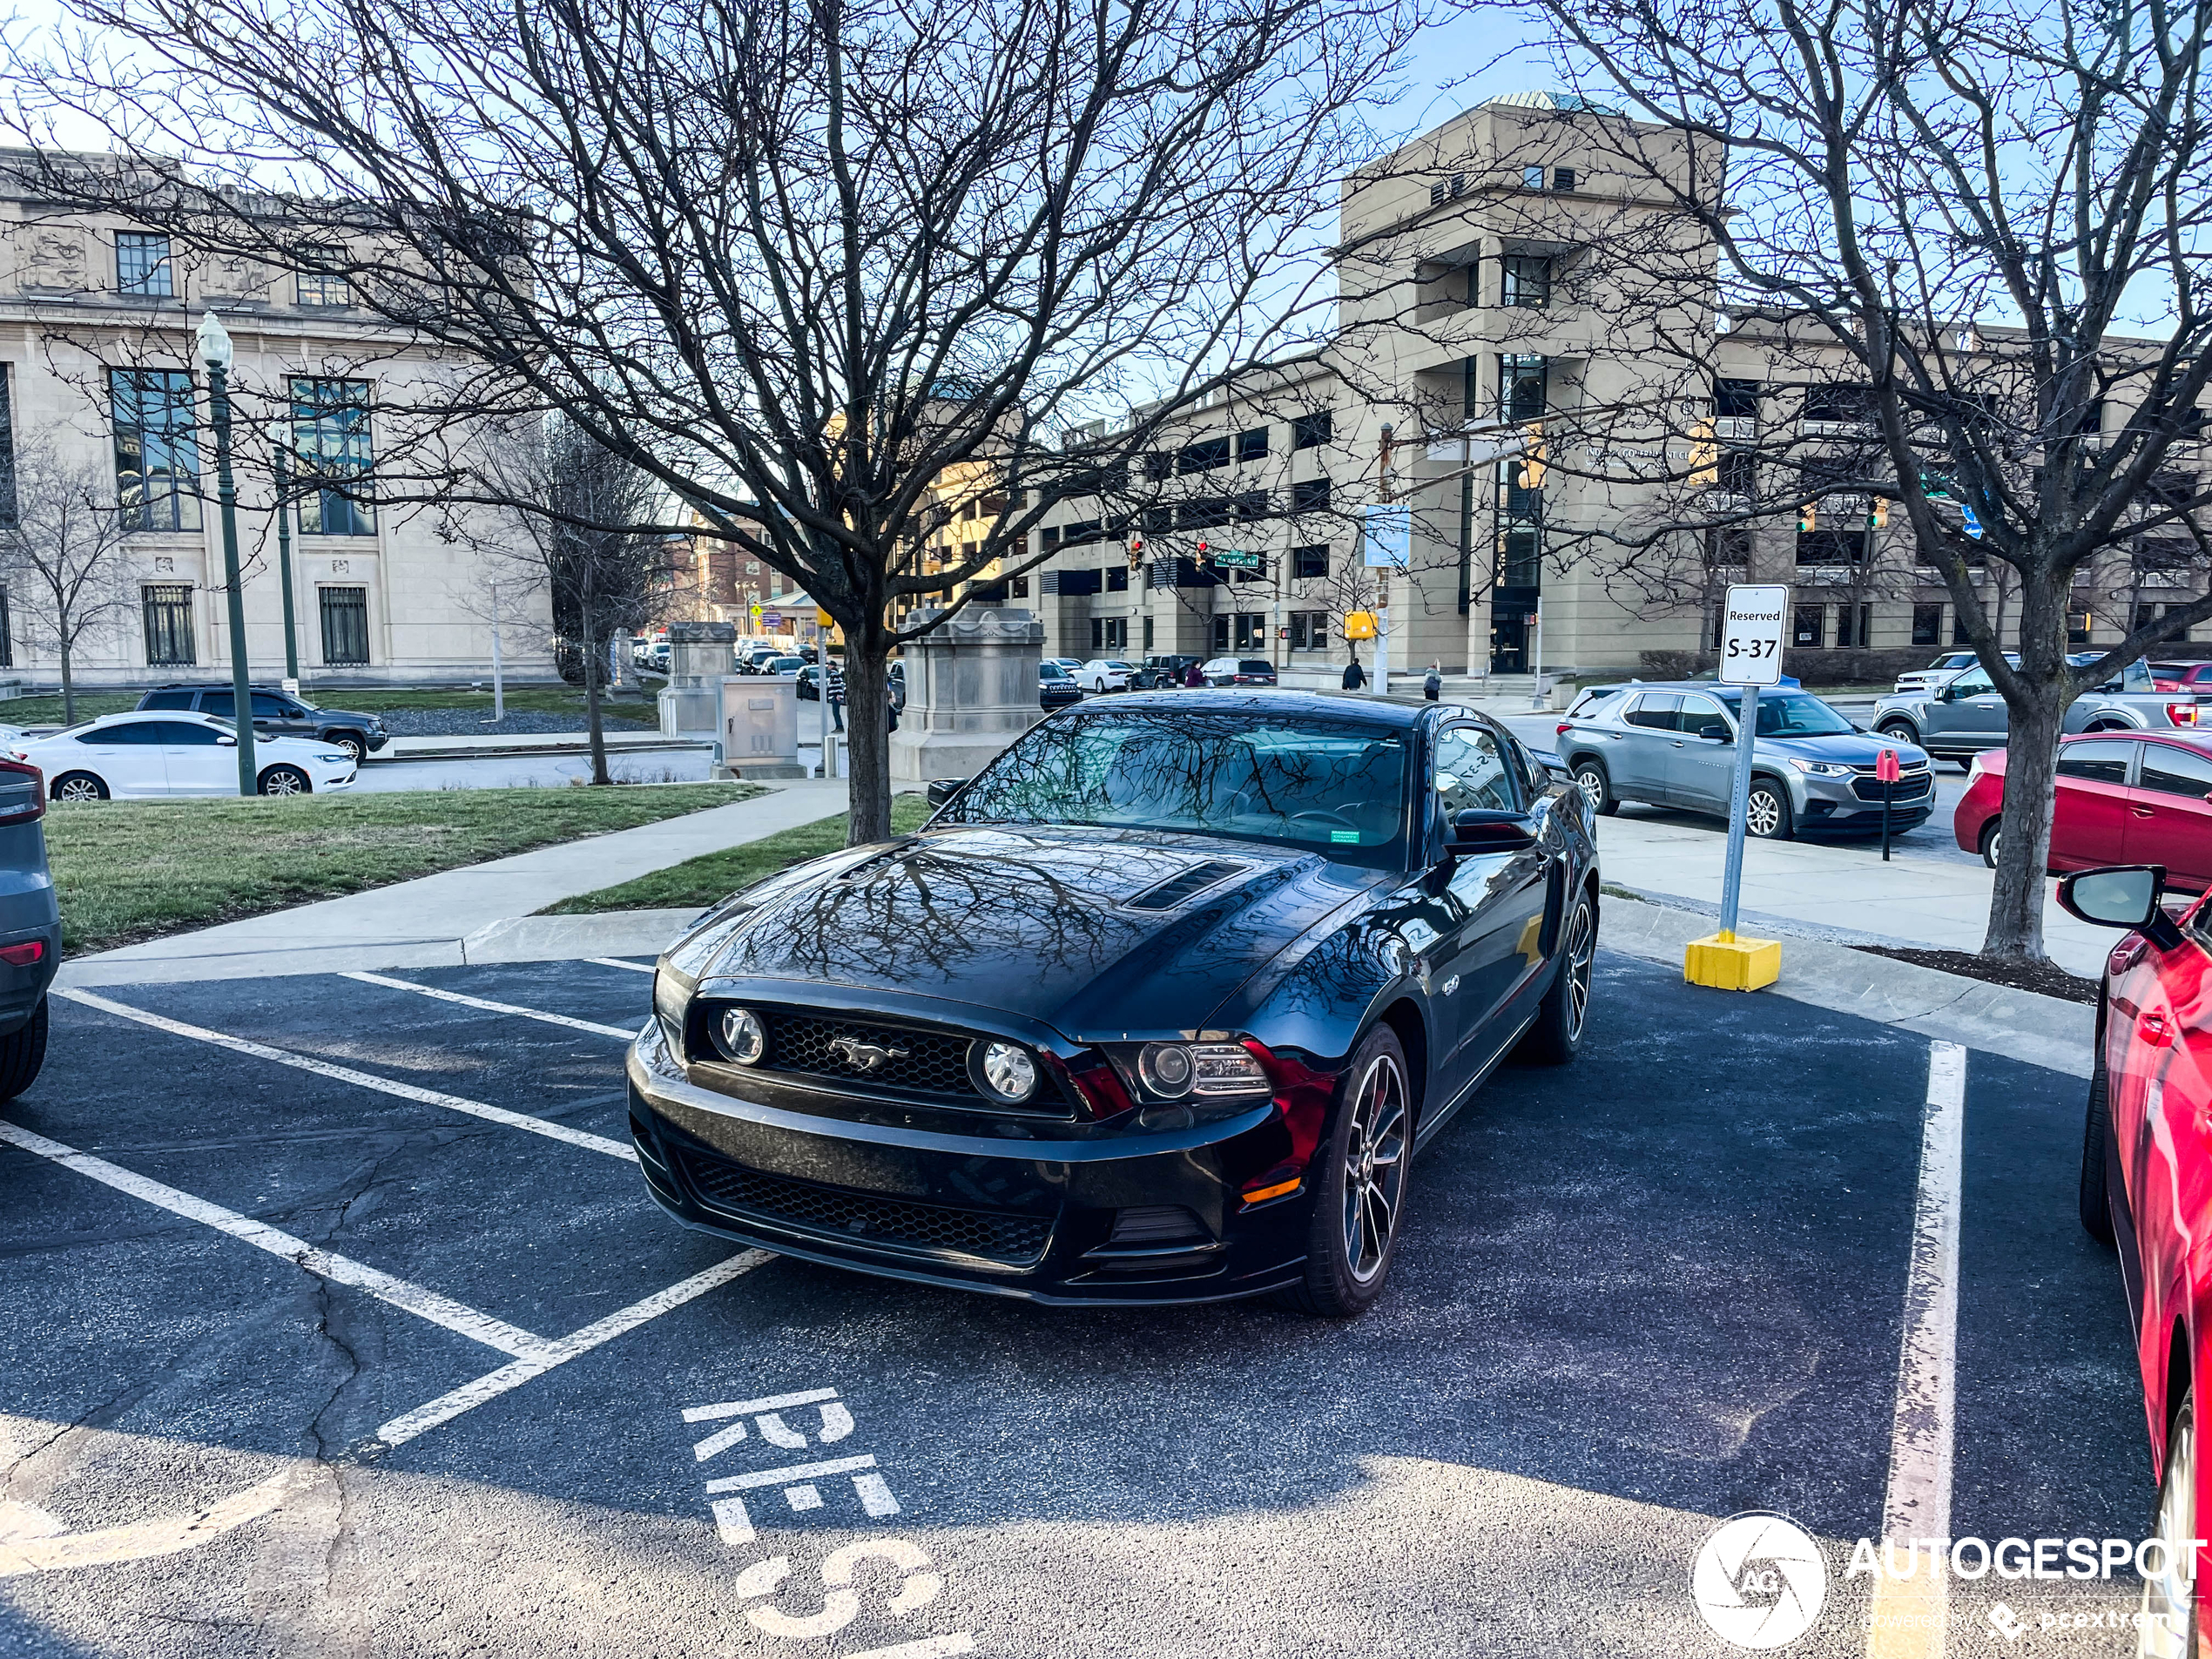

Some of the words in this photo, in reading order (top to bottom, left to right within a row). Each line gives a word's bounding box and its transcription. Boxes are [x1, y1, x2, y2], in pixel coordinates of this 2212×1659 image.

[1730, 610, 1781, 621] Reserved
[1727, 638, 1777, 658] S-37
[681, 1386, 977, 1659] RES
